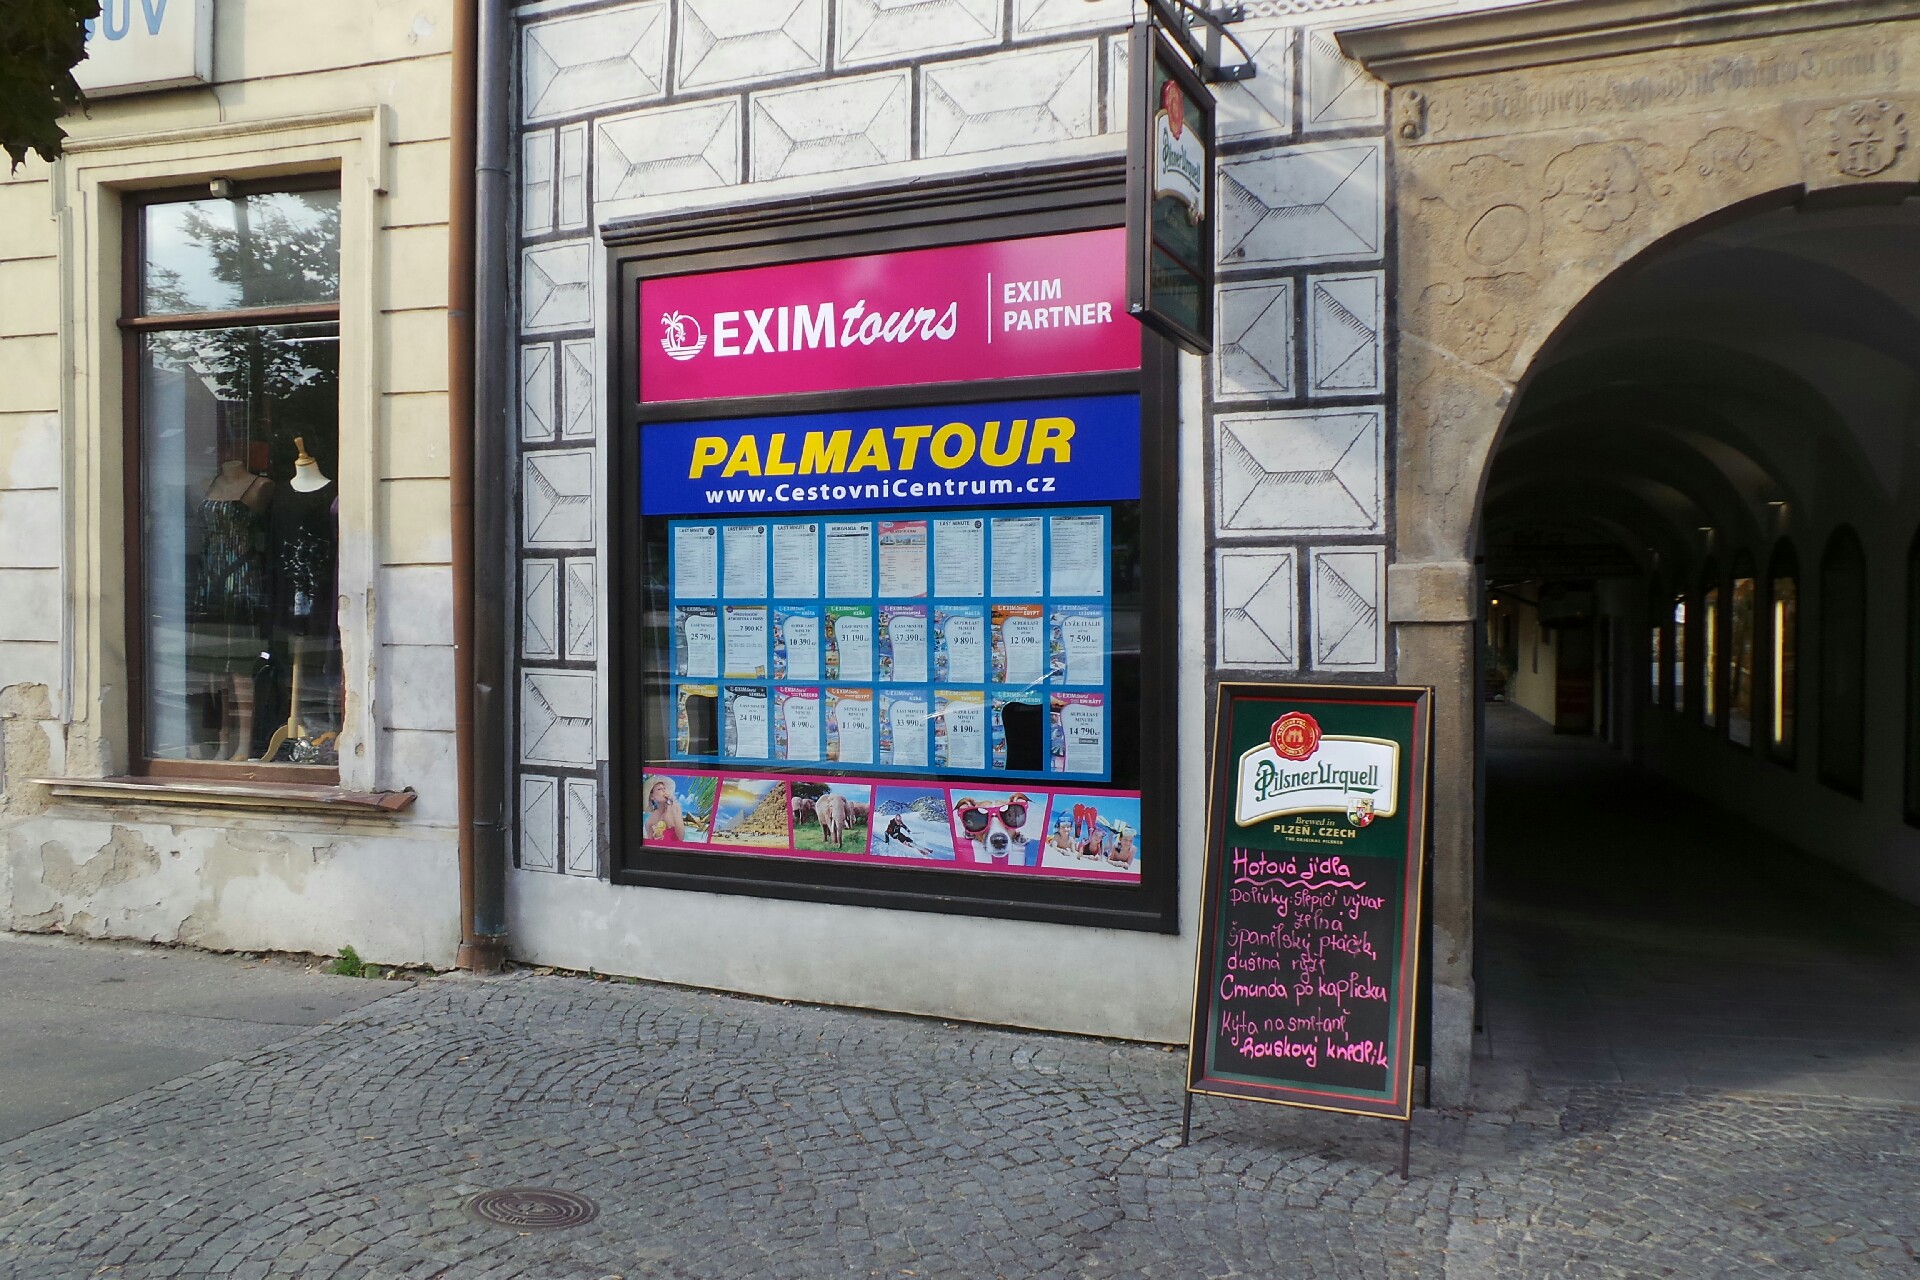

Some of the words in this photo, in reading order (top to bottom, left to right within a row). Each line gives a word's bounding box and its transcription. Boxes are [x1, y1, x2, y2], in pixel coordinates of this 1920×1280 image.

[1004, 278, 1062, 304] EXIM
[1004, 302, 1112, 332] PARTNER
[688, 416, 1076, 479] PALMATOUR
[705, 477, 1056, 504] www.CestovniCentrum.cz
[1254, 759, 1319, 802] Pilsner
[1295, 816, 1326, 826] Brewed
[1326, 818, 1335, 826] in
[1318, 827, 1356, 838] CZECH
[1233, 847, 1297, 878] Hotová
[1220, 973, 1288, 1000] Cmunda
[1293, 983, 1314, 1007] po
